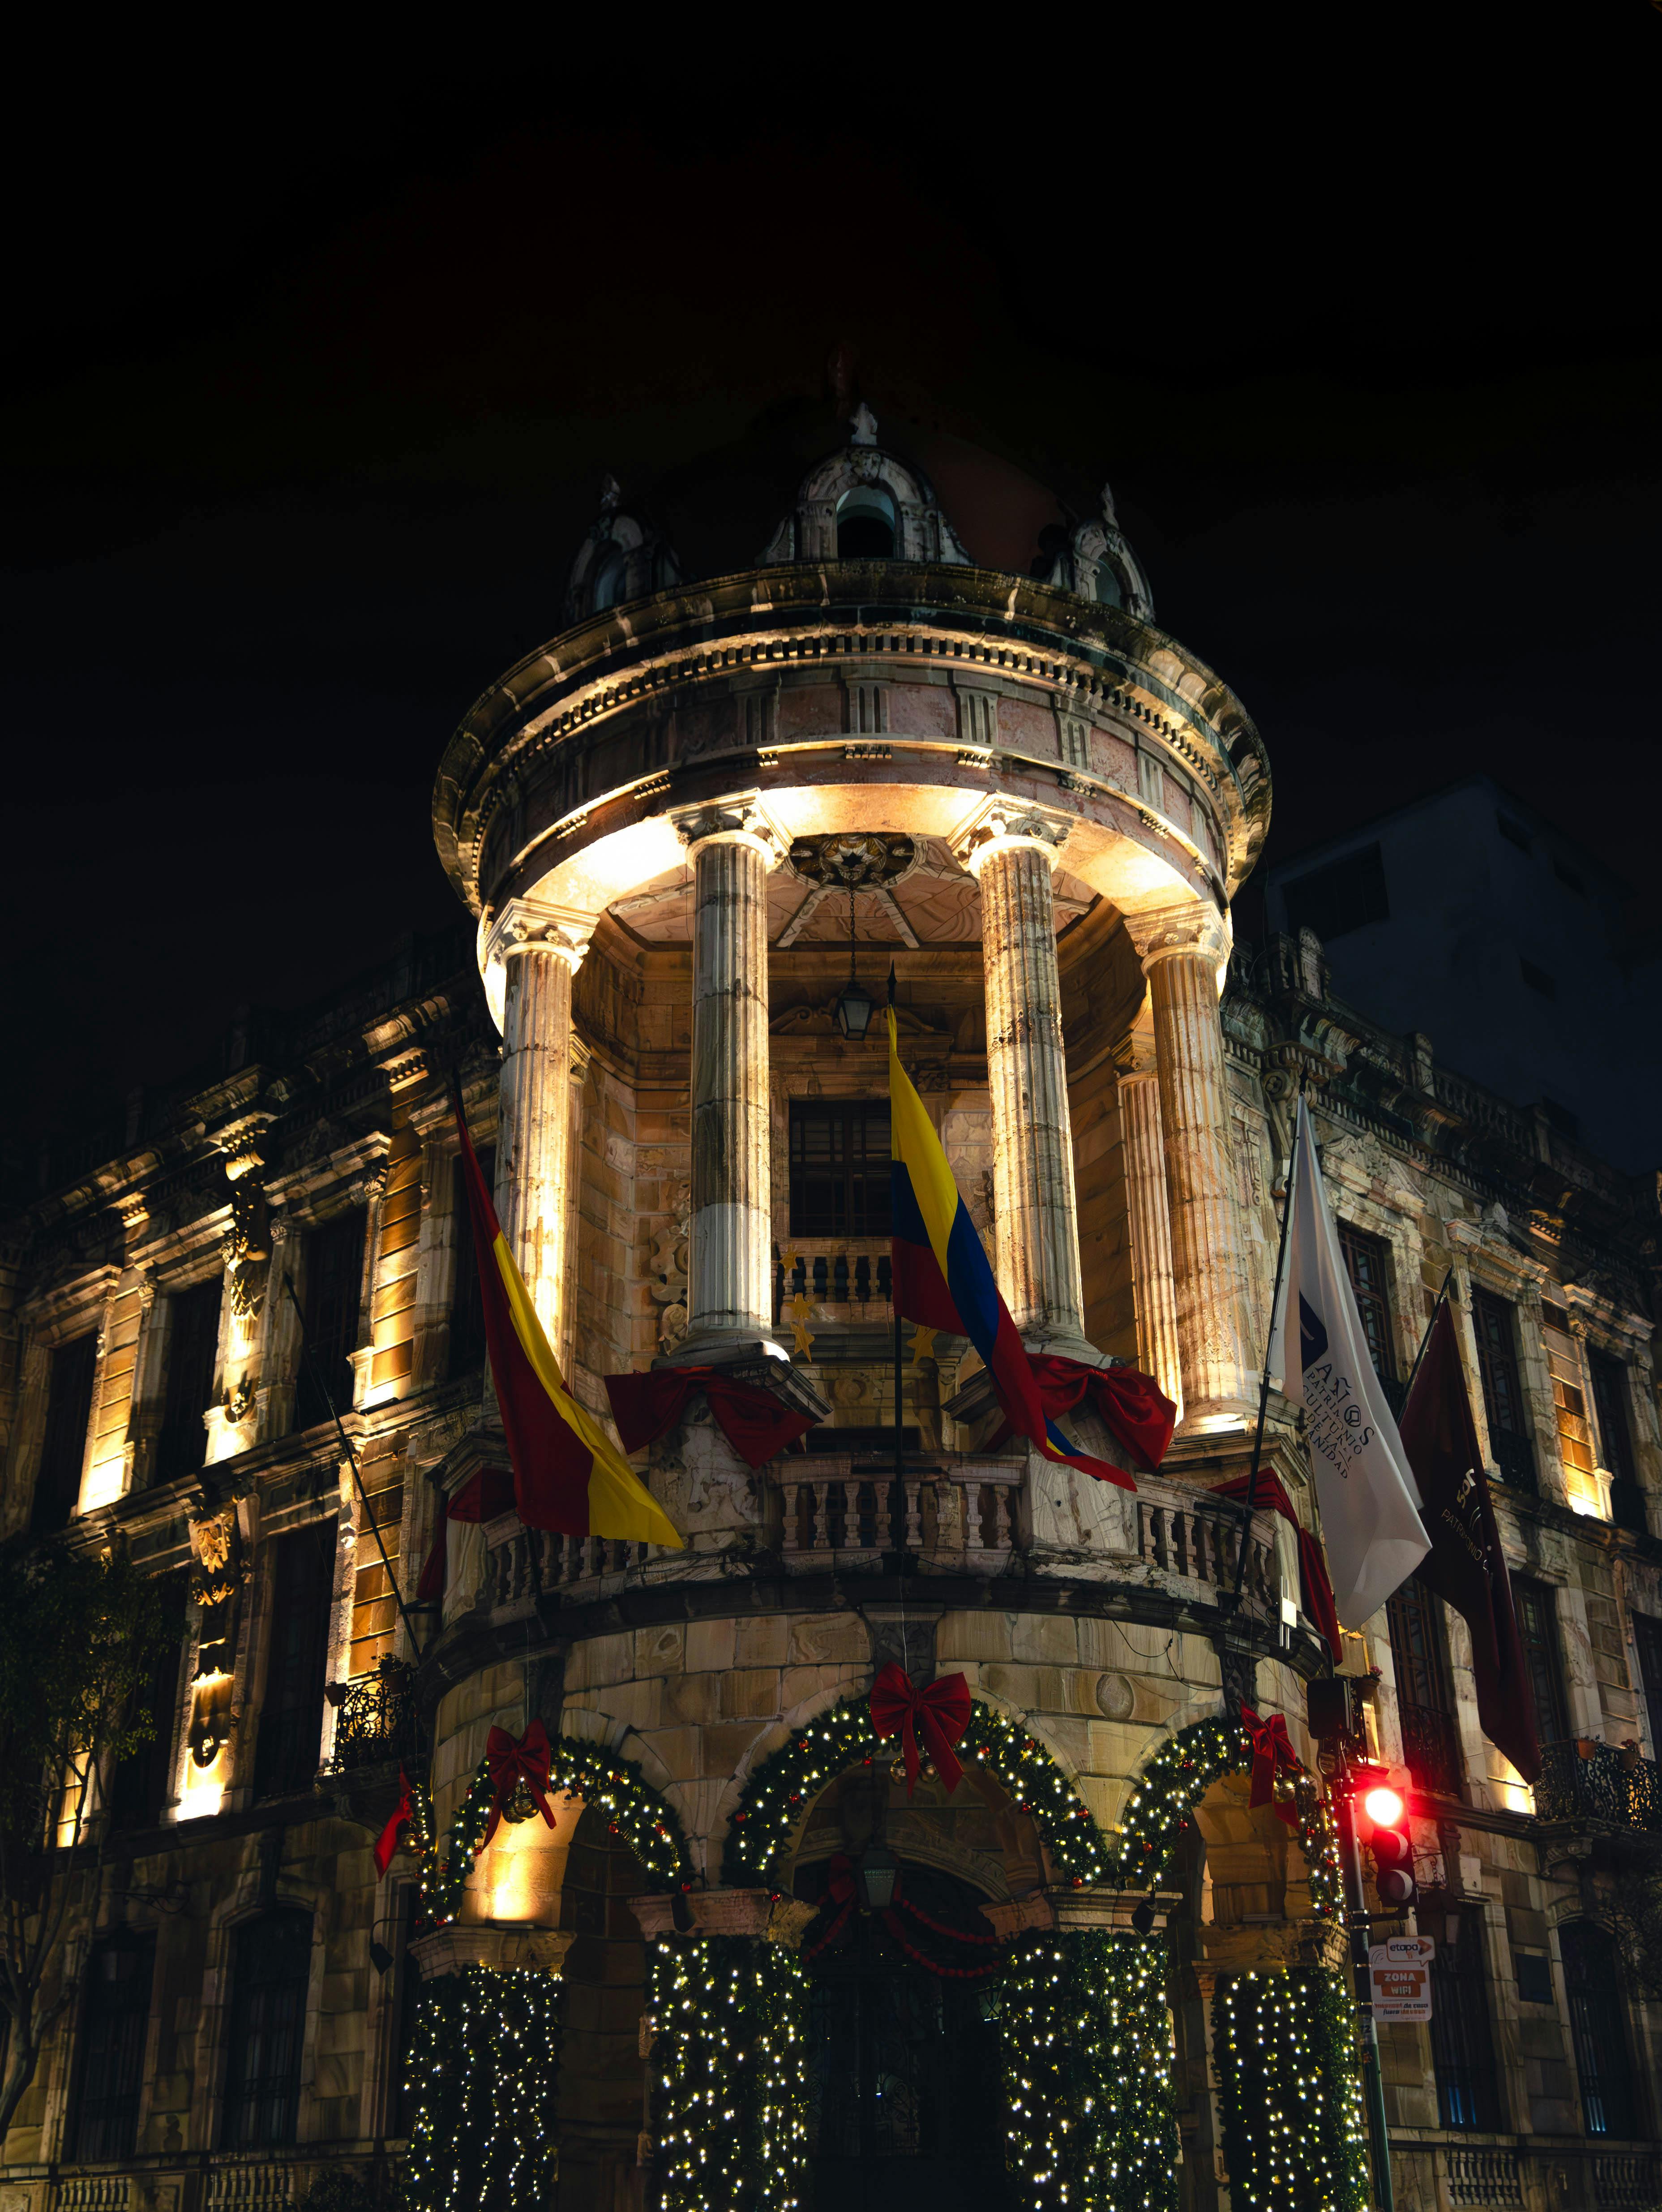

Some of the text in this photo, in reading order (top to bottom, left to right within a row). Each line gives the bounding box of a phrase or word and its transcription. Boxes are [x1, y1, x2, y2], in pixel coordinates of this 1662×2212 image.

[1315, 1364, 1374, 1446] AÑOS
[1303, 1385, 1352, 1467] CULTUR
[1306, 1413, 1338, 1451] DE LA
[1390, 1944, 1418, 1953] etapa
[1384, 1973, 1416, 1981] ZONA
